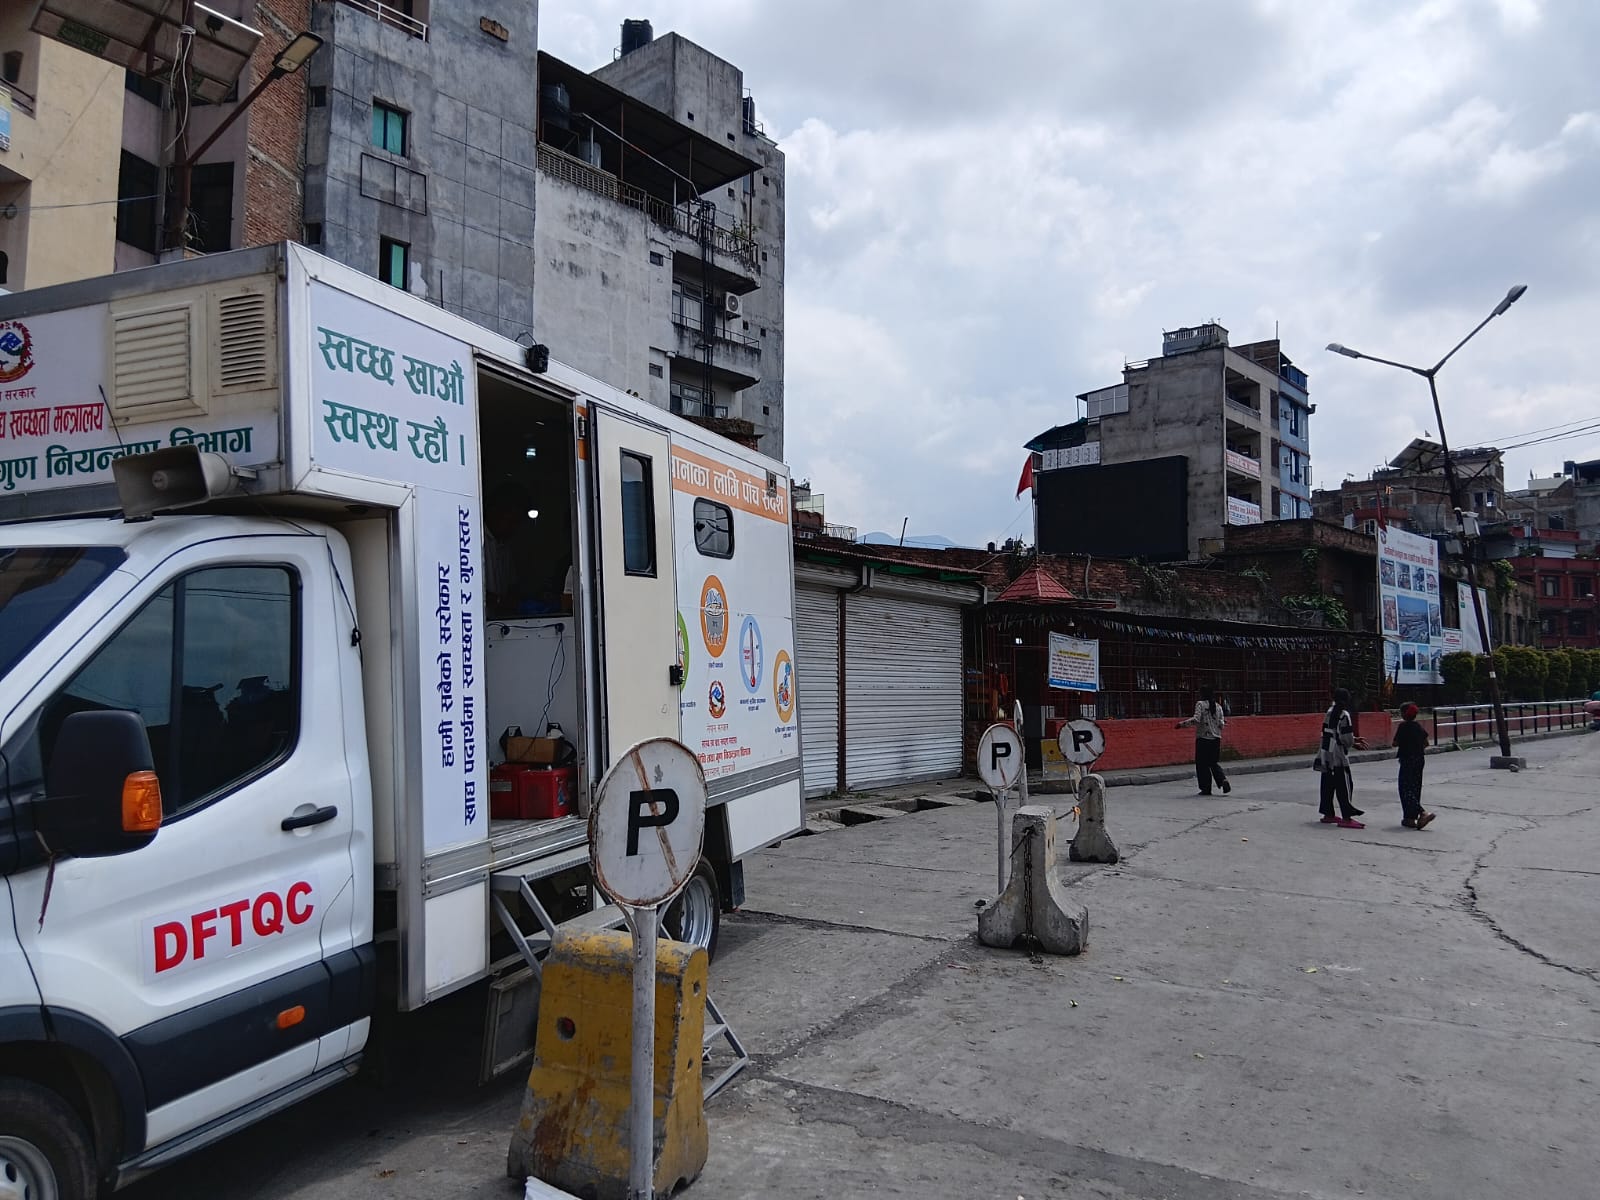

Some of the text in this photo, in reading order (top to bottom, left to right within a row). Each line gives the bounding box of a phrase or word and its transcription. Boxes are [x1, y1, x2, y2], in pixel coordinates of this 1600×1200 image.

[317, 326, 396, 387] स्वच्छ
[5, 387, 37, 401] सरकार
[9, 407, 51, 440] स्वच्छता
[53, 402, 105, 435] मन्त्रालय
[323, 400, 399, 451] स्वस्थ
[713, 469, 740, 500] लागि
[435, 561, 454, 768] हामी सबैको सरोकार
[458, 504, 476, 826] खाद्य पदार्थमा स्वच्छता र गुणस्तर
[991, 742, 1012, 771] P
[1071, 730, 1094, 752] P
[625, 788, 680, 857] P
[153, 881, 315, 974] DFTQC
